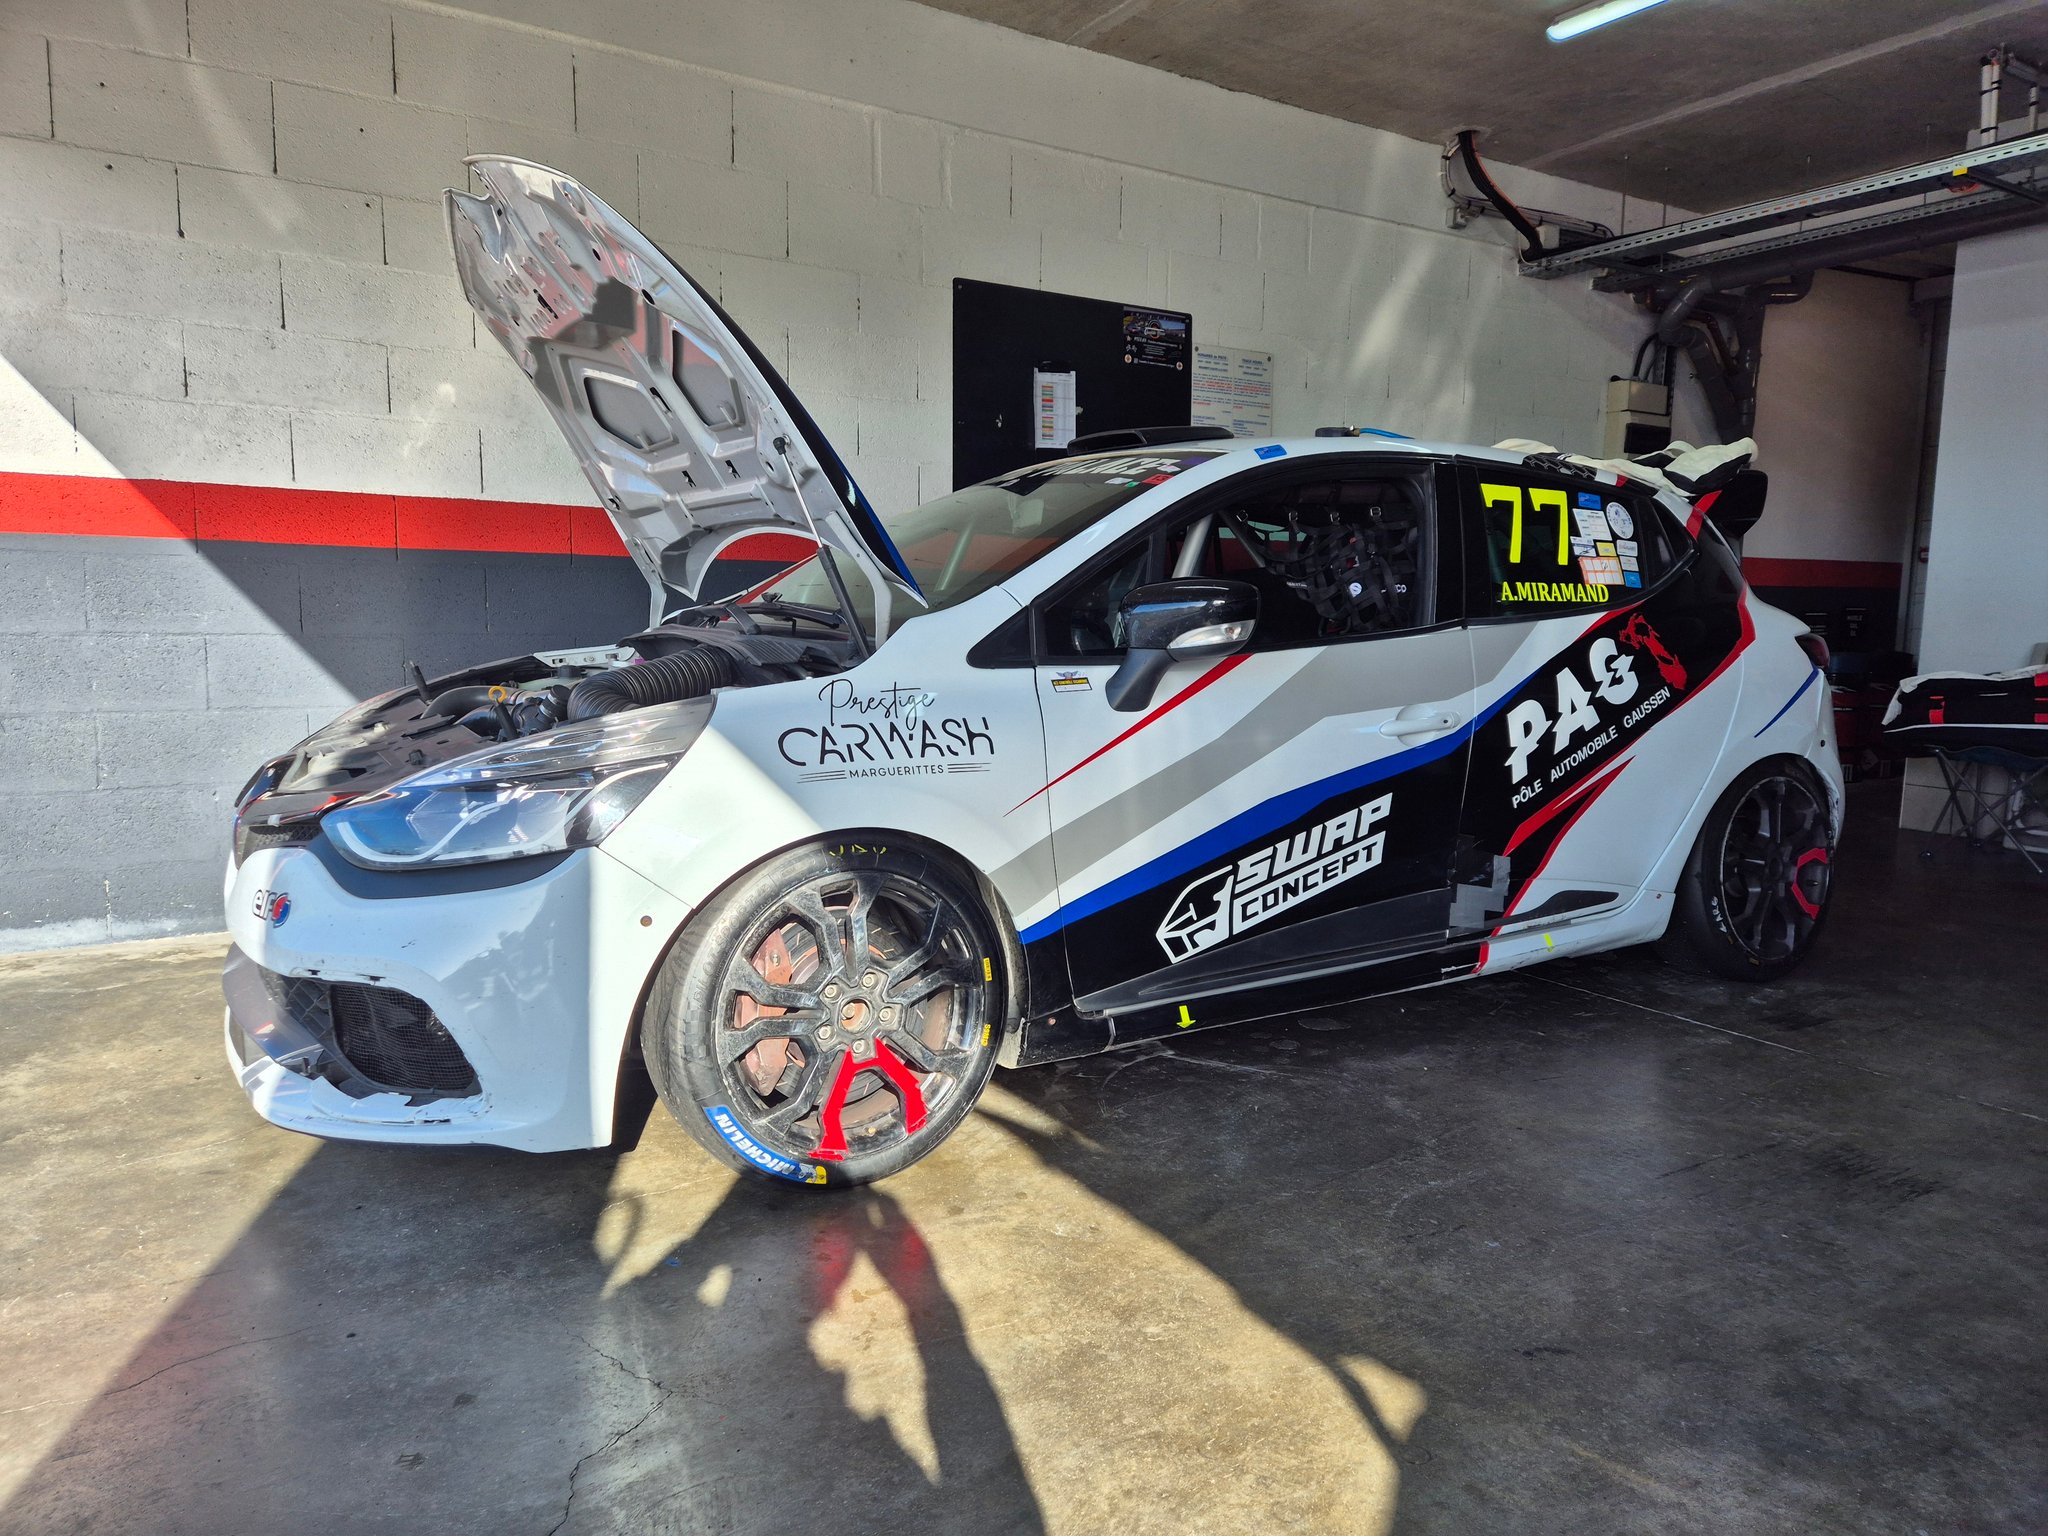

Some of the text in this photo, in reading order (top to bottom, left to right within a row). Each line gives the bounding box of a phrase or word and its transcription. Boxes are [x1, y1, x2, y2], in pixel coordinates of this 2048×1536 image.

[1480, 483, 1569, 566] 77
[1501, 581, 1609, 603] A.MIRAMAND
[818, 679, 935, 731] Prestige
[777, 716, 995, 767] CARWASH
[849, 764, 944, 778] MARGUERITTES
[1512, 686, 1671, 808] PÔLE AUTOMOBILE GAUSSEN
[1234, 792, 1393, 894] SWAP
[1241, 842, 1378, 923] CONCEPT
[692, 895, 758, 1008] PILOT SPORT
[713, 1112, 796, 1175] MICHELIN
